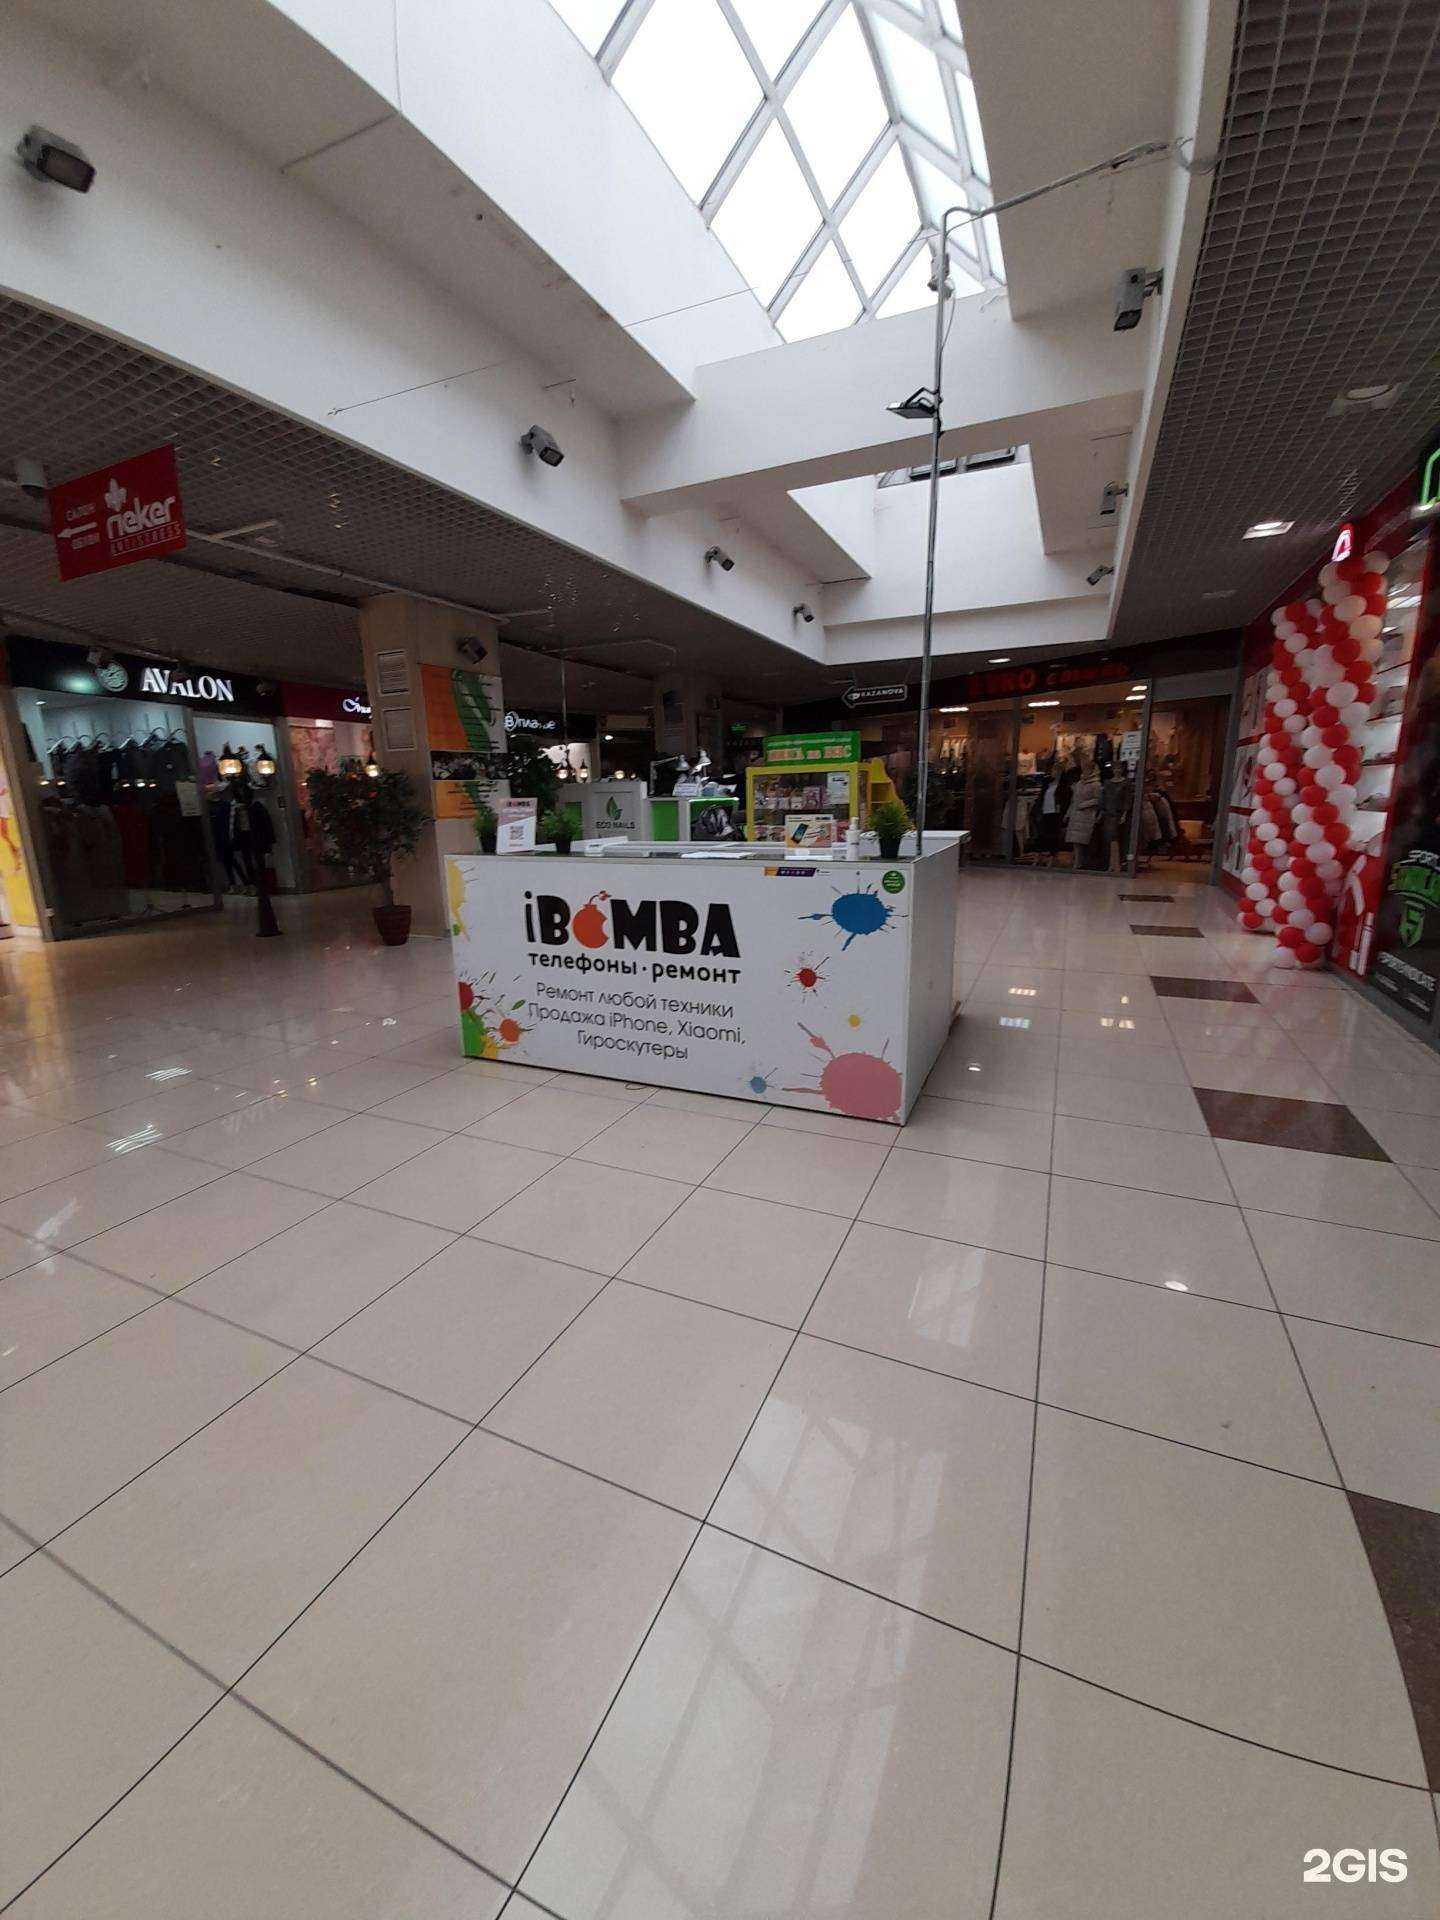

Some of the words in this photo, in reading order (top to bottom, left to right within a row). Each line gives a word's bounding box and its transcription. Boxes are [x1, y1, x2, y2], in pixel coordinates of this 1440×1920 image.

[141, 667, 234, 702] AVALON
[528, 953, 637, 974] телефоны
[652, 962, 741, 984] ремонт
[536, 982, 594, 1002] Ремонт
[599, 991, 657, 1010] любой
[662, 998, 734, 1018] техники
[528, 1003, 605, 1026] Продажа
[609, 1013, 672, 1035] iPhone,
[678, 1021, 746, 1045] Xiaomi,
[577, 1030, 688, 1060] Гироскутеры
